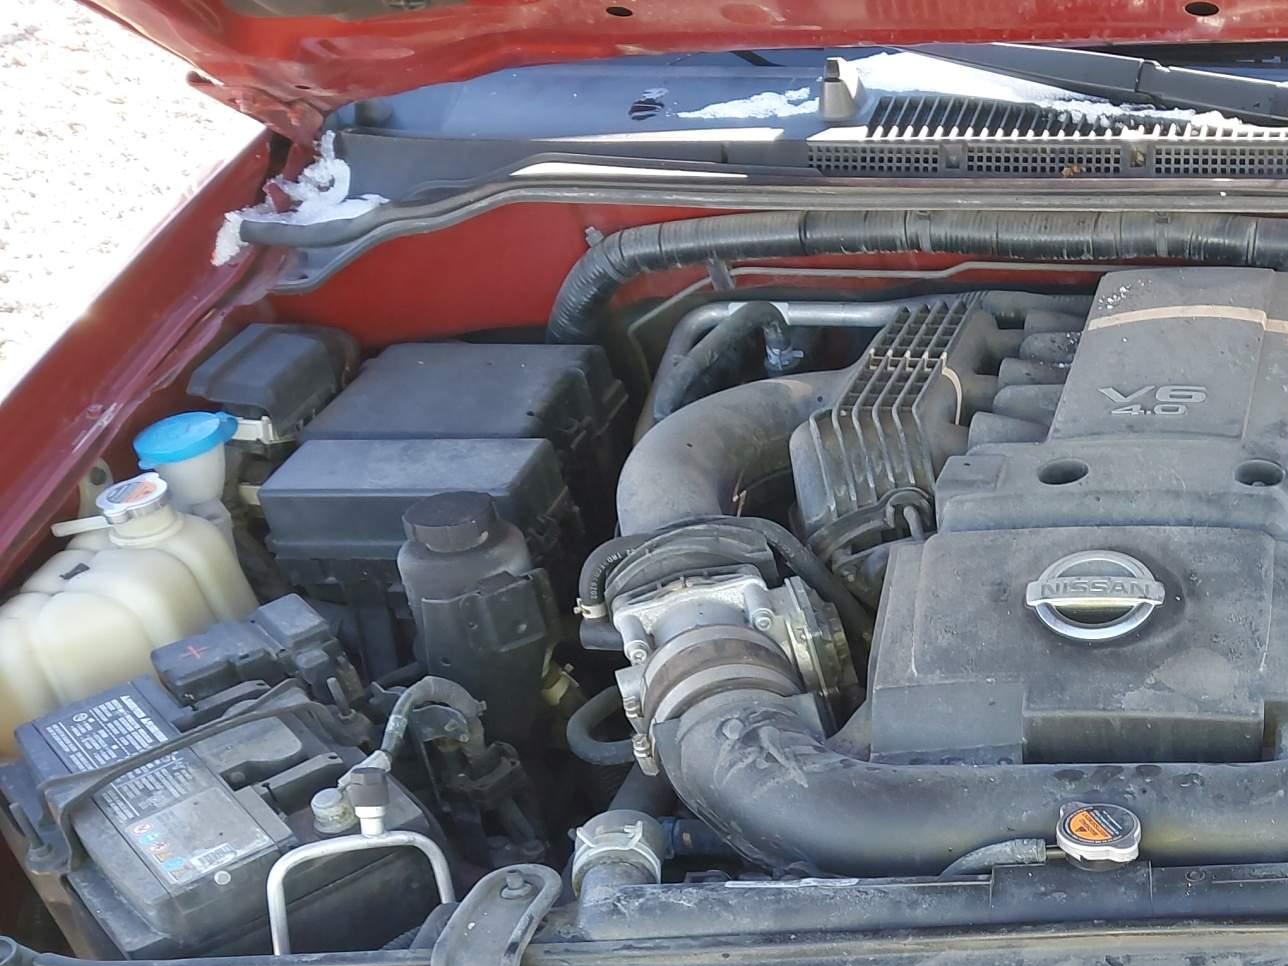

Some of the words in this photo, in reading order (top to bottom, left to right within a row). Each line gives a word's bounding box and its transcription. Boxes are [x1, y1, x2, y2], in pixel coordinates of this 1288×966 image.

[1097, 384, 1207, 402] V6
[1111, 403, 1188, 415] 4.0
[1040, 580, 1152, 597] NISSAN
